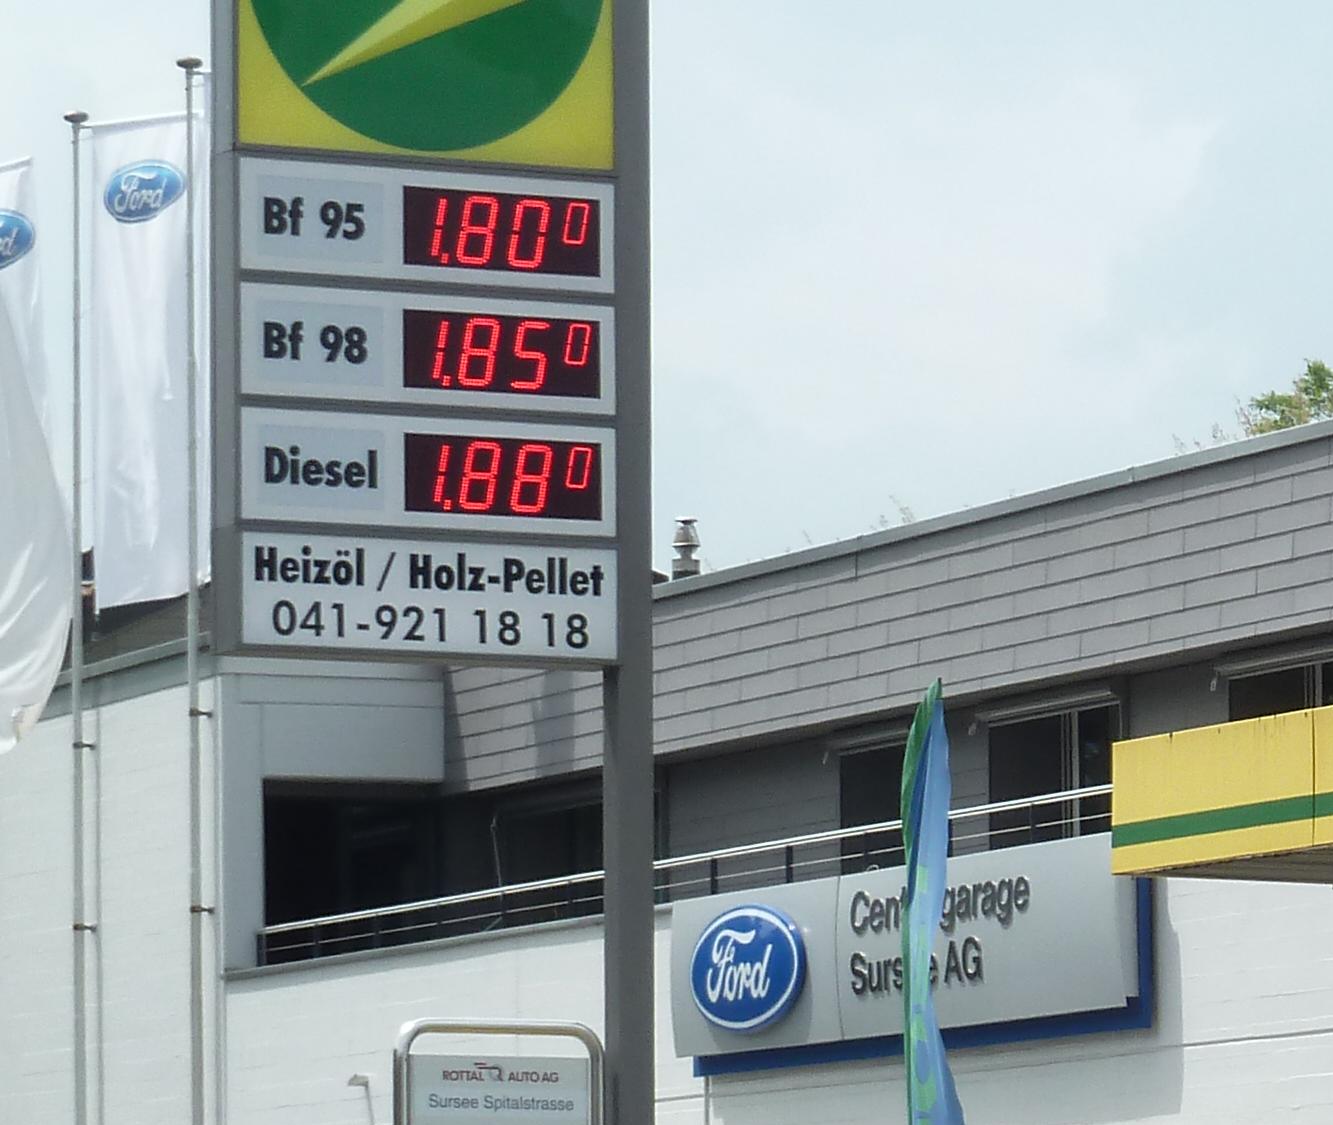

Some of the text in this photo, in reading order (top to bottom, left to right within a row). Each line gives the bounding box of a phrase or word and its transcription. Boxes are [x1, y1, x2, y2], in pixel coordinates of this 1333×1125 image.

[114, 172, 168, 214] Ford
[262, 196, 365, 240] Bf 95
[262, 320, 369, 365] Bf 98
[263, 445, 379, 490] Diesel
[254, 545, 365, 586] Heizöl
[408, 552, 604, 597] Holz-Pellet
[271, 599, 590, 650] 041-921 18 18
[706, 928, 774, 1004] Ford
[850, 935, 984, 997] Surse AG
[442, 1070, 560, 1084] ROTTAL AUTO AG
[428, 1093, 575, 1112] Sursee Spitalstrasse
